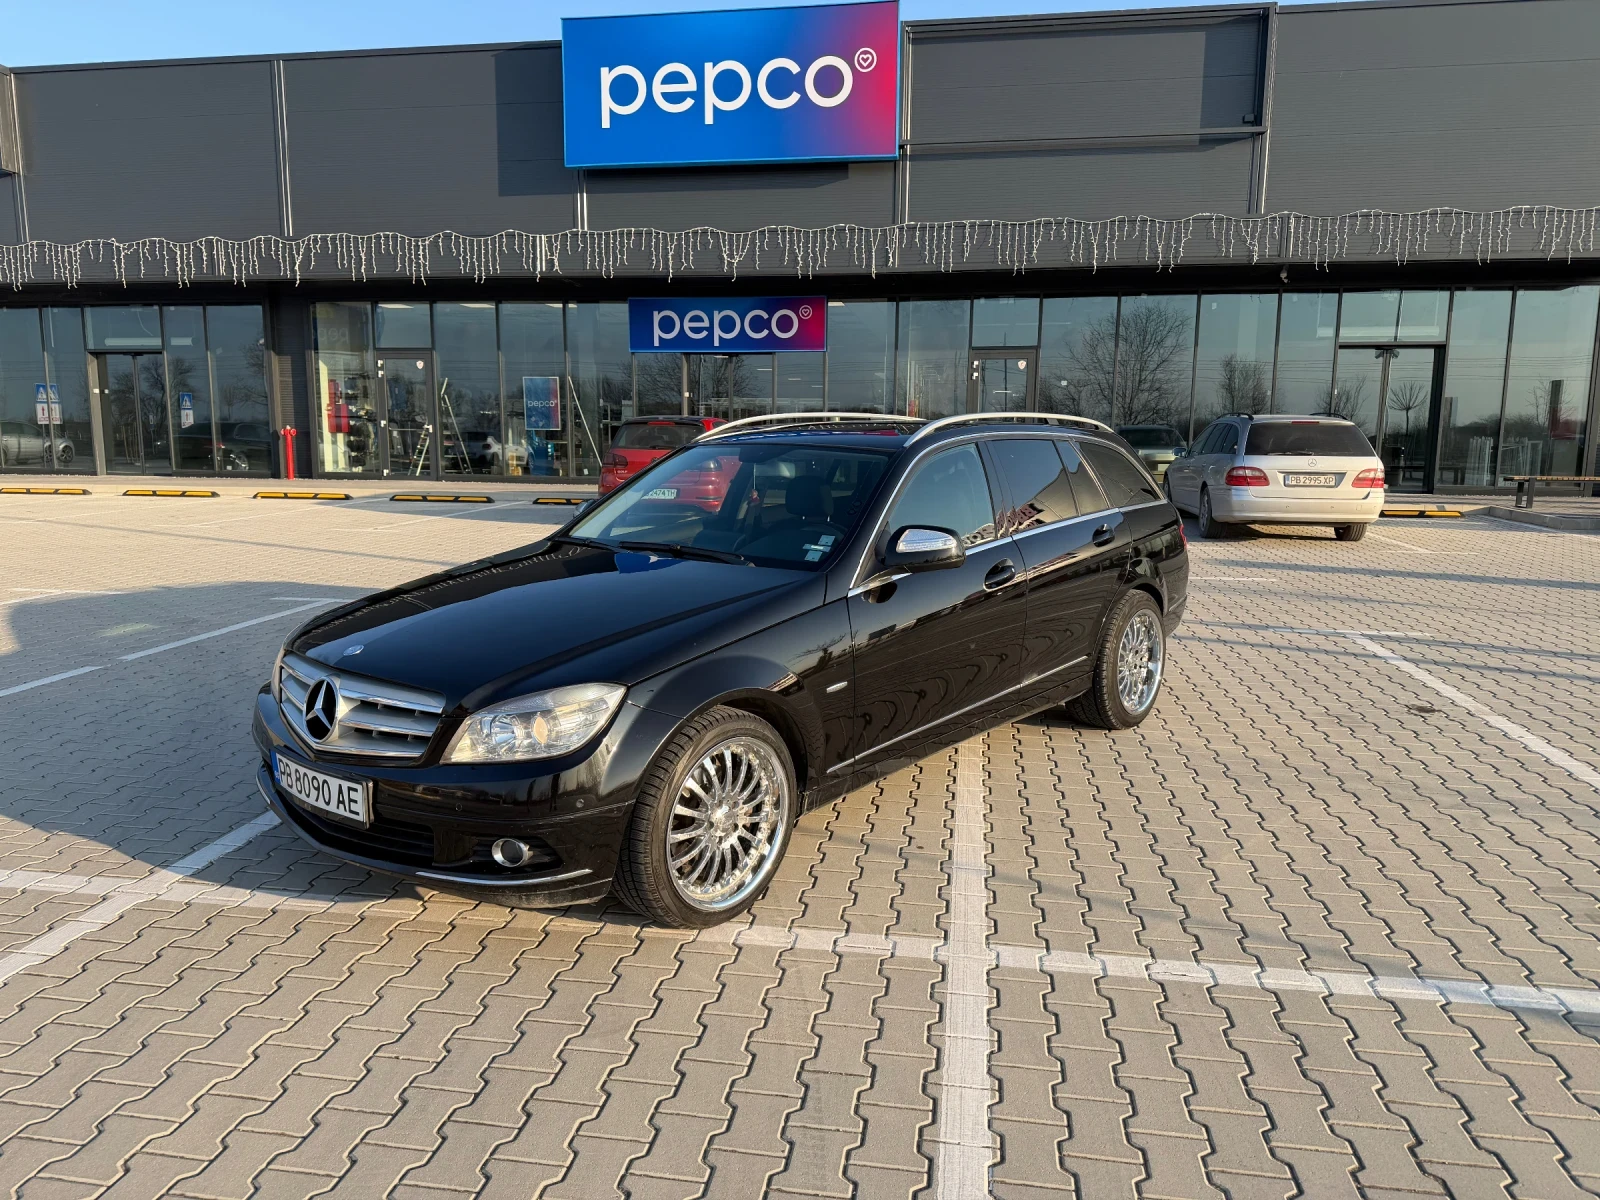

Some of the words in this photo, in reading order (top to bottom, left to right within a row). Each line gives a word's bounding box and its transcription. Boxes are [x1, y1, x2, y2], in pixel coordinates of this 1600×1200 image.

[601, 56, 853, 128] pepco
[653, 309, 798, 346] pepco
[528, 400, 555, 408] pepco
[1290, 476, 1301, 484] PB
[1302, 476, 1321, 484] 2995
[1323, 477, 1334, 485] XP
[278, 757, 293, 790] PB
[295, 768, 331, 807] 8090
[336, 783, 360, 816] AE
